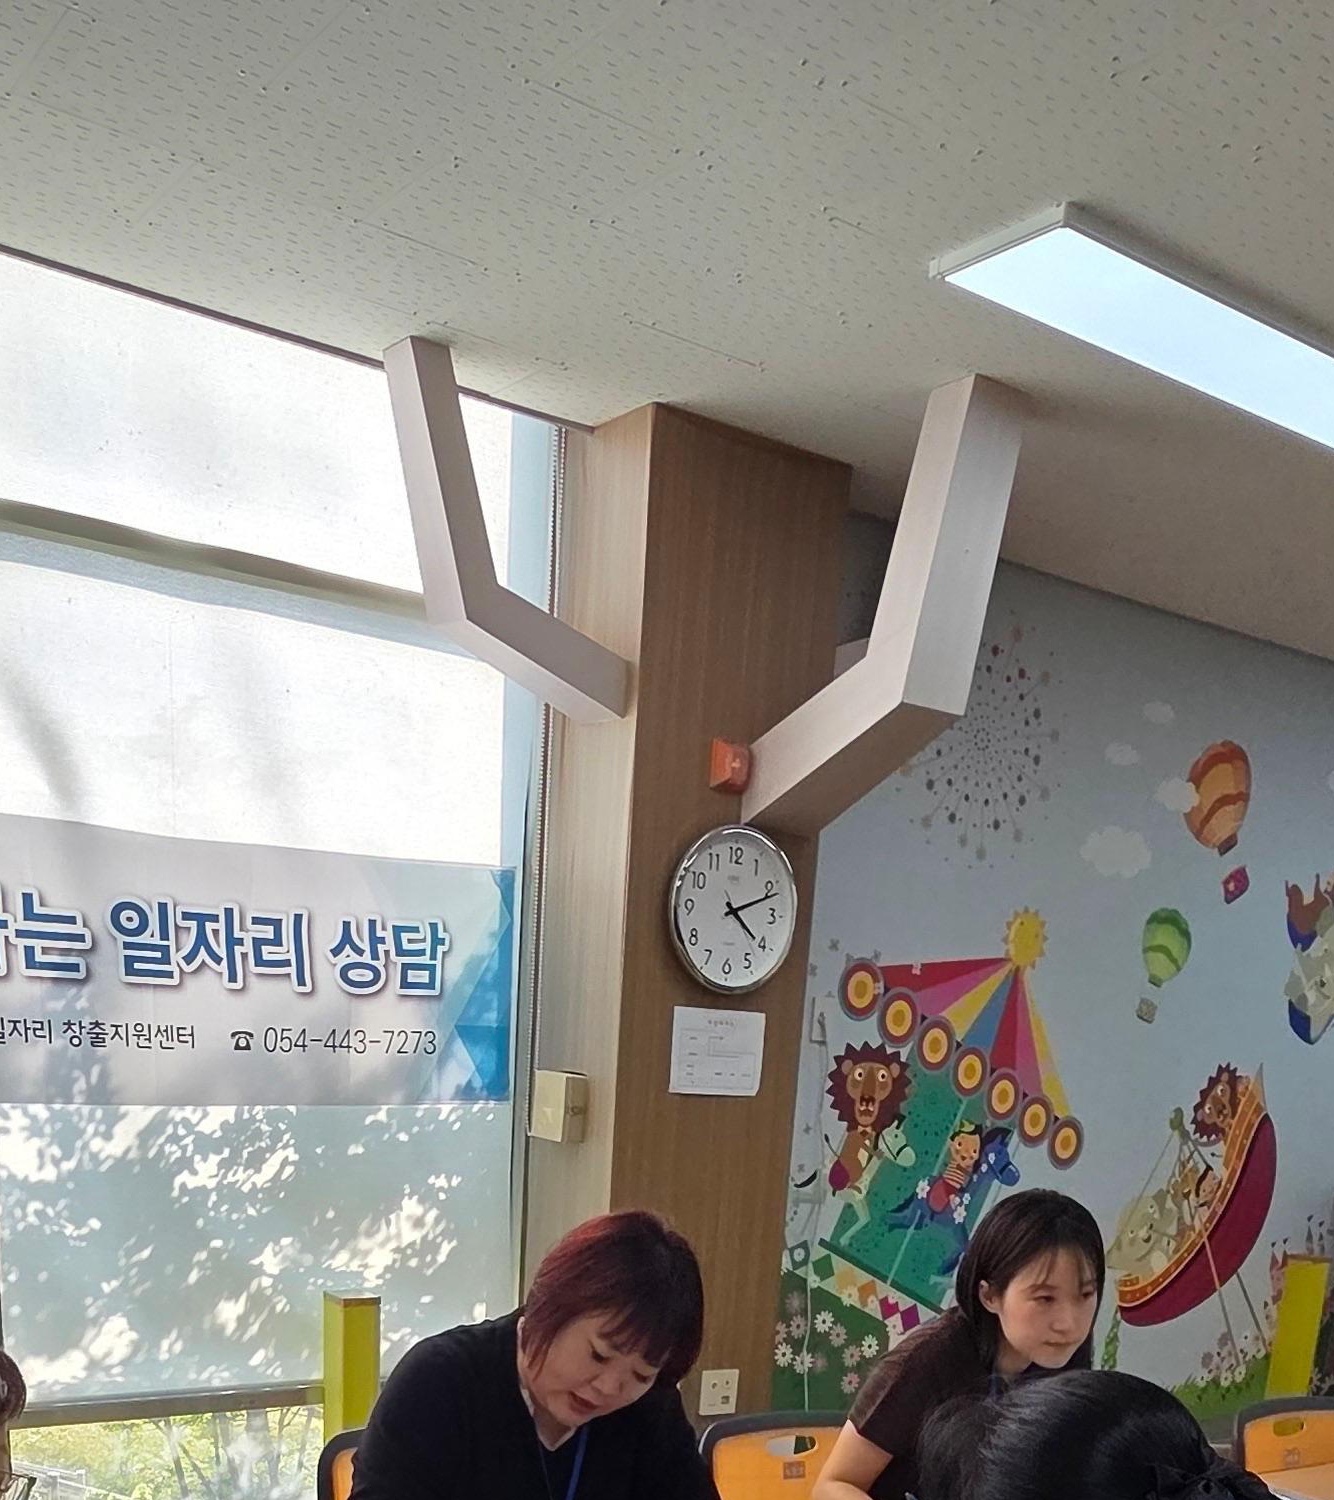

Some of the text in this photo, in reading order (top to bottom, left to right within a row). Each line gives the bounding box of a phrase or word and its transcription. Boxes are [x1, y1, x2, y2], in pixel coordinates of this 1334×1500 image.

[708, 852, 720, 871] 11
[729, 846, 744, 865] 12
[753, 859, 759, 876] 1
[692, 871, 706, 889] 10
[684, 898, 695, 916] 9
[767, 907, 776, 925] 3
[109, 899, 308, 988] 일자리
[328, 918, 446, 991] 상담
[689, 928, 698, 946] 8
[758, 936, 766, 952] 4
[704, 949, 713, 965] 7
[743, 952, 752, 969] 5
[721, 958, 732, 975] 6
[61, 1019, 196, 1050] 창출지원센터
[263, 1026, 437, 1056] 054-443-7273
